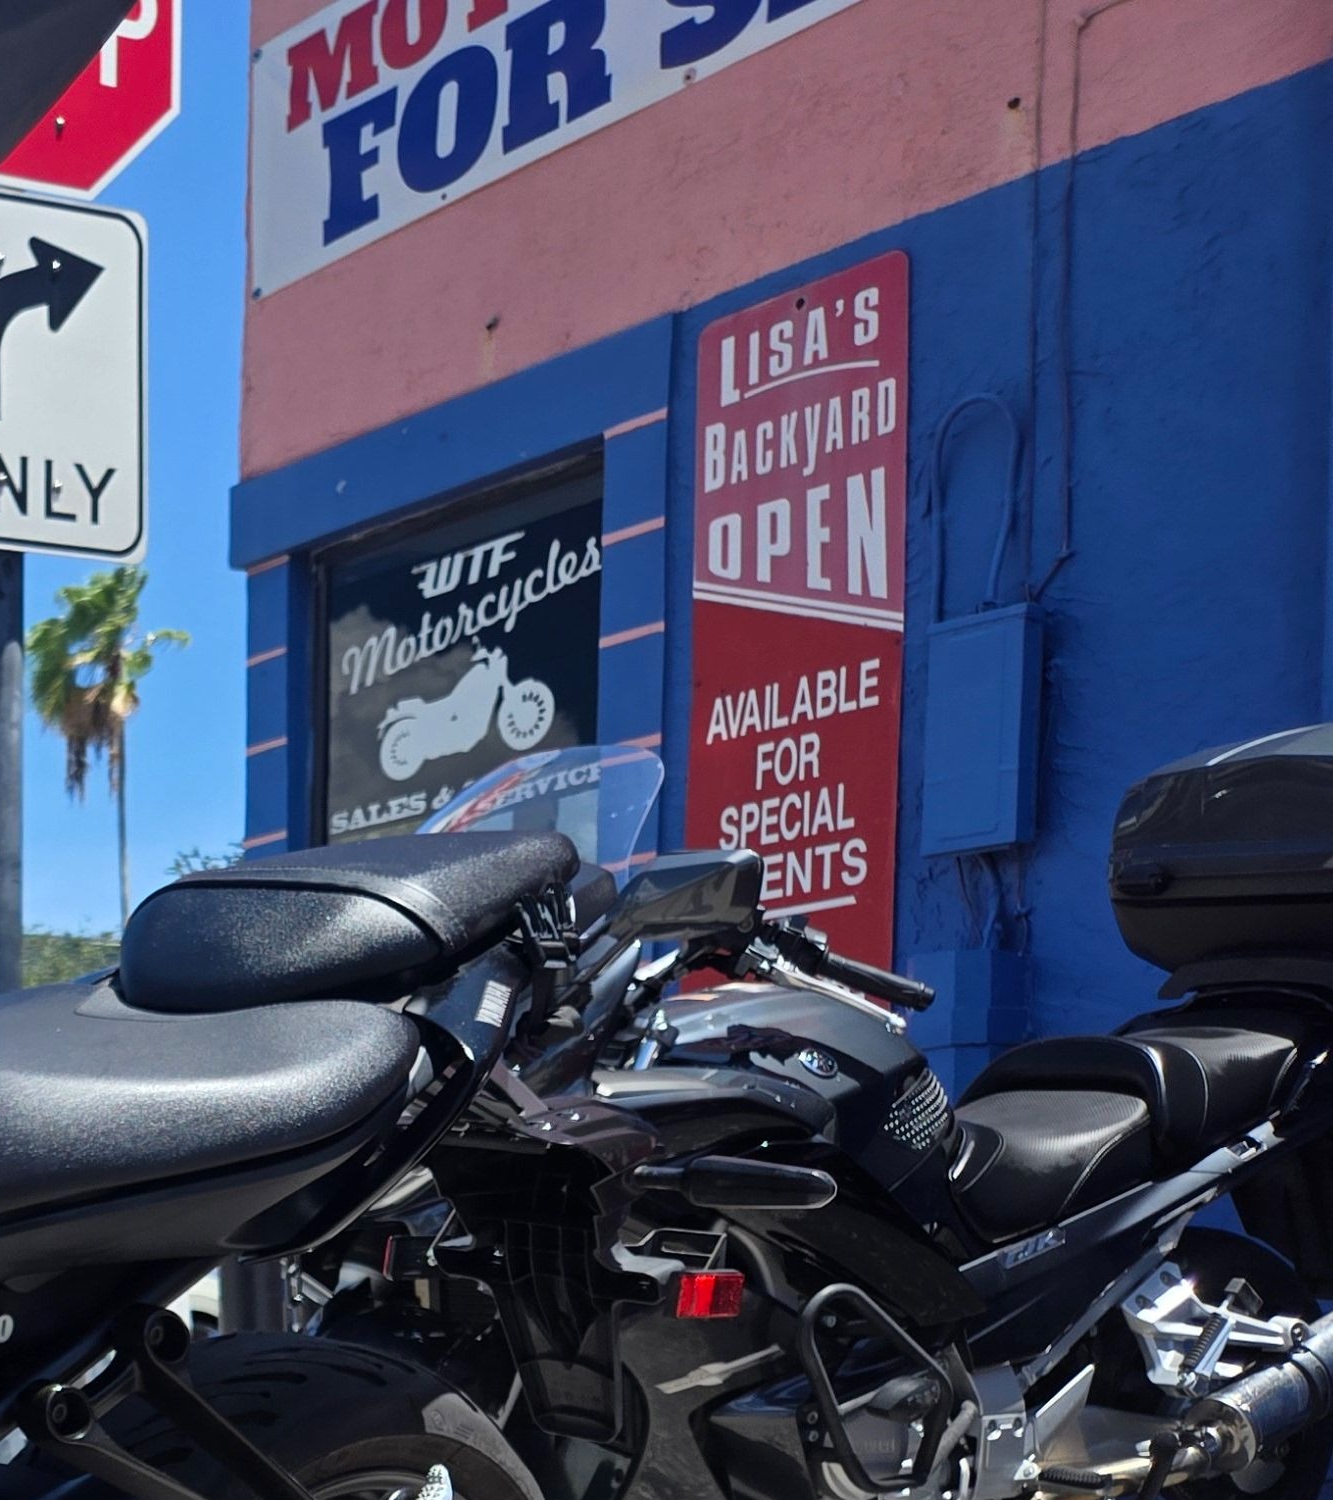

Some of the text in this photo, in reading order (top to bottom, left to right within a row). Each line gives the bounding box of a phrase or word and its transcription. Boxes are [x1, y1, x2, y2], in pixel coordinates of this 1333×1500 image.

[322, 0, 612, 248] FOR
[719, 286, 880, 408] LISA'S
[704, 377, 897, 494] BACKYARD
[410, 530, 526, 600] WTF
[707, 466, 888, 600] OPEN
[341, 536, 603, 696] Motorcycles
[705, 658, 880, 745] AVAILABLE
[329, 790, 427, 835] SALES
[463, 762, 602, 811] ERVICE
[755, 732, 821, 790] FOR
[719, 782, 856, 851] SPECIAL
[759, 838, 868, 901] ENTS
